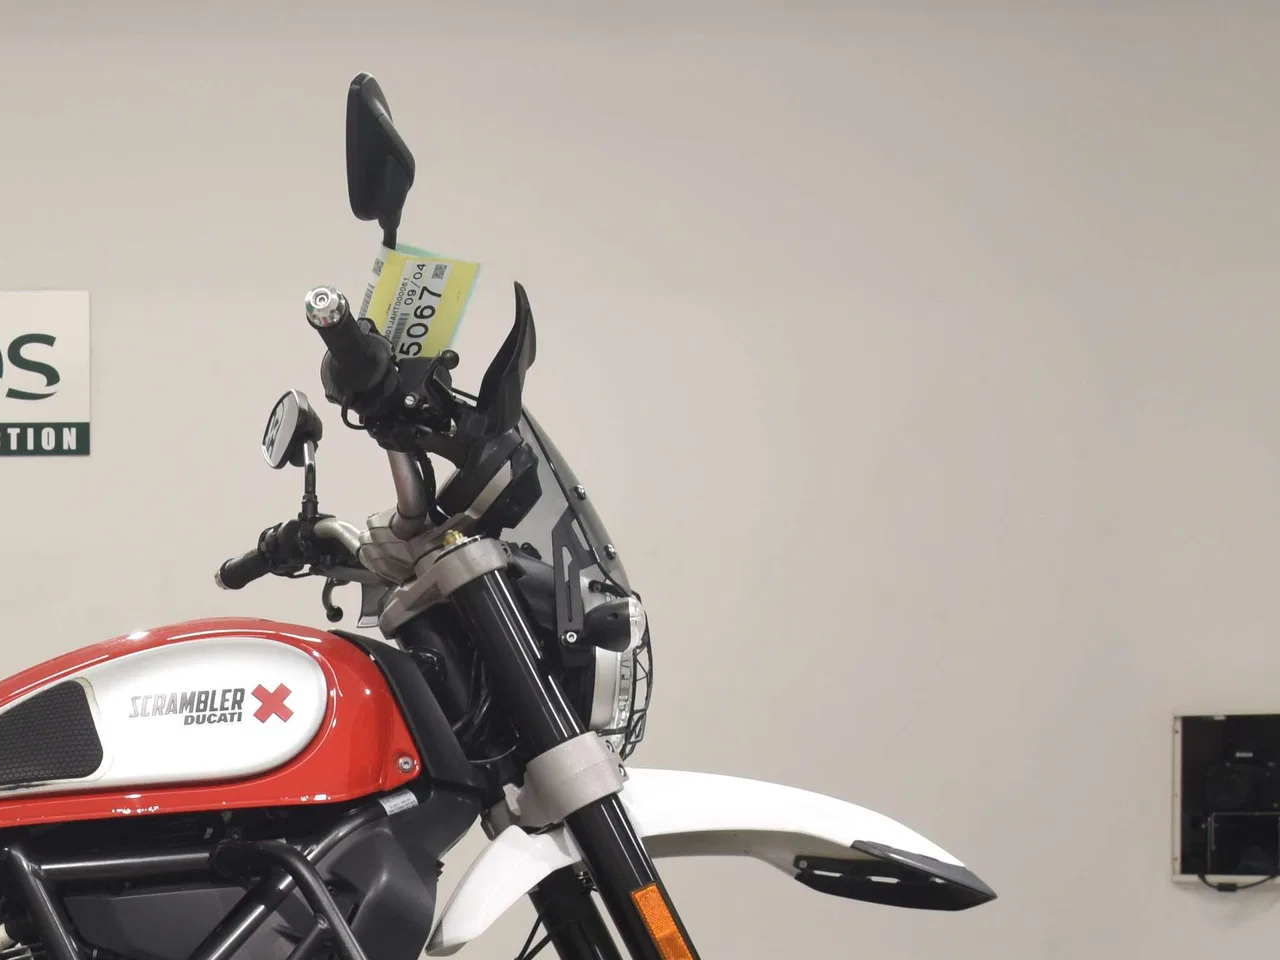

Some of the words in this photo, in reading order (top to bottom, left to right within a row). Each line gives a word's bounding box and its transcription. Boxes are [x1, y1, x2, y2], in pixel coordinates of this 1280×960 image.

[403, 263, 426, 306] 09/04
[399, 286, 442, 356] 5067
[128, 688, 245, 718] SCRAMBLER
[183, 711, 243, 726] DUCATI
